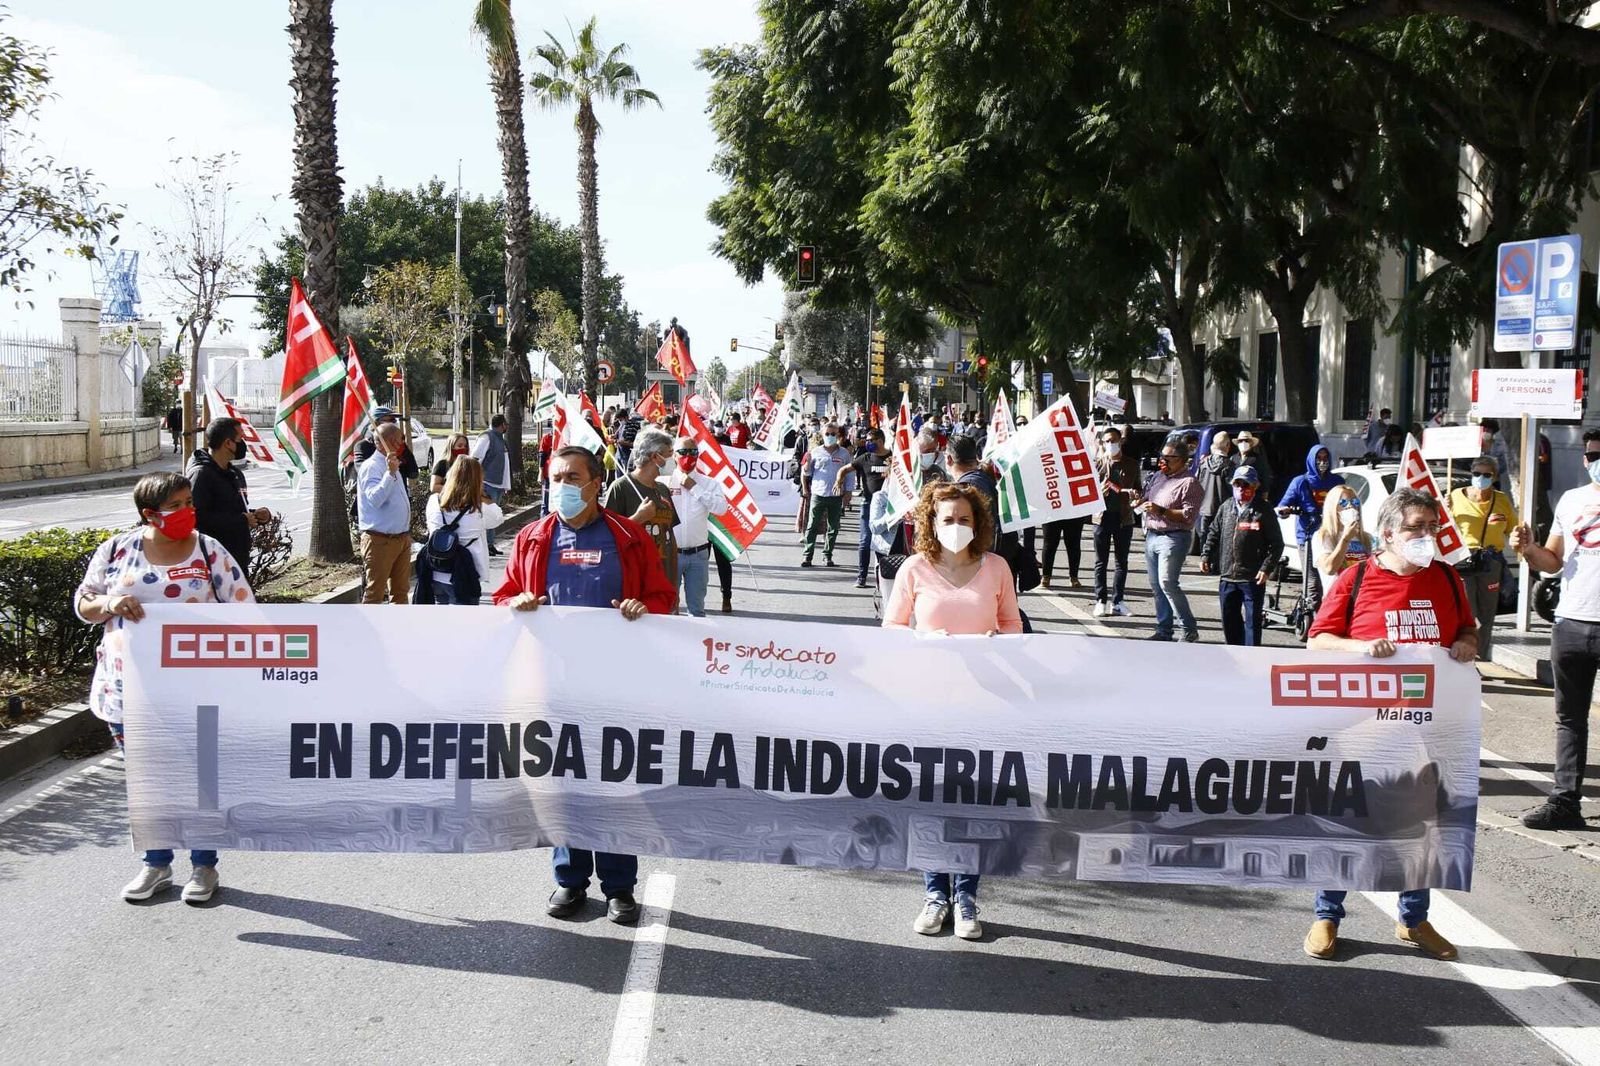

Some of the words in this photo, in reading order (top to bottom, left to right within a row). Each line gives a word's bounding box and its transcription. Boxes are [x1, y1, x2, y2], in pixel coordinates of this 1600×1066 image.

[1539, 241, 1575, 300] P
[1506, 386, 1553, 394] PERSONAS
[1040, 453, 1063, 510] Málaga
[1385, 610, 1398, 626] SIN
[1399, 609, 1438, 626] INDUSTRIA
[1387, 626, 1399, 641] NO
[1400, 625, 1413, 640] HAY
[1414, 624, 1440, 640] FUTURO
[169, 633, 282, 659] CCOO
[702, 637, 732, 662] 1er
[735, 640, 837, 665] sindicato
[262, 667, 318, 685] Málaga
[706, 658, 731, 675] de
[1279, 672, 1398, 700] CCOO
[1376, 707, 1433, 725] Málaga
[289, 722, 353, 779] EN
[369, 719, 588, 780] DEFENSA
[600, 726, 665, 785] DE
[678, 729, 741, 789] LA
[754, 735, 1032, 808] INDUSTRIA
[1046, 736, 1370, 819] MALAGUEÑA
